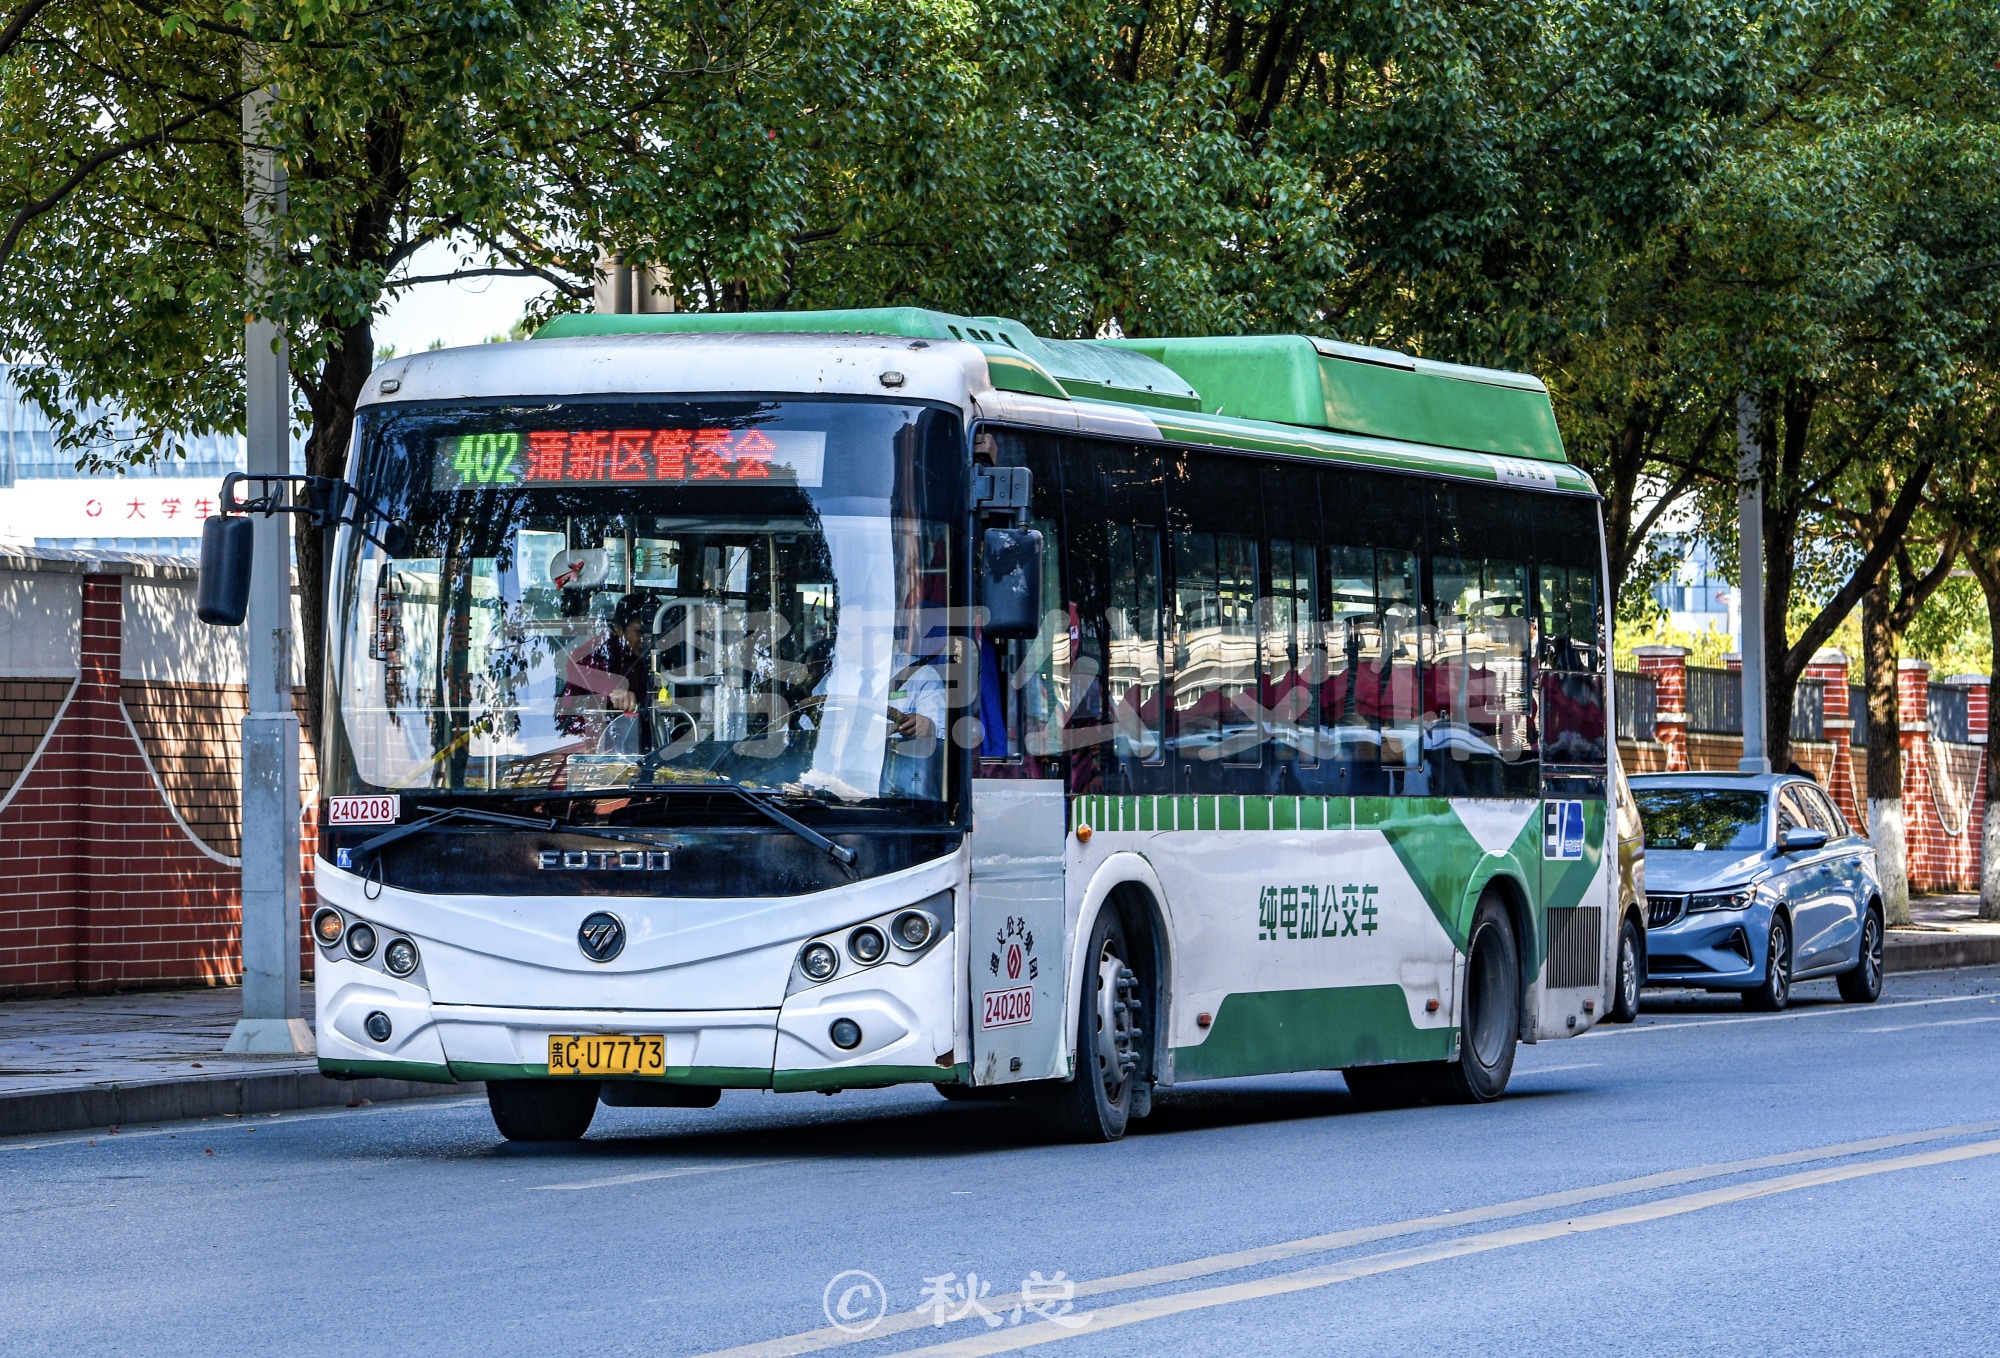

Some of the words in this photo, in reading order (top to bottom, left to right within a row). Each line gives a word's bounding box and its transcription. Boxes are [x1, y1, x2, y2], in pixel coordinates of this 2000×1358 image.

[453, 433, 518, 483] 402
[332, 800, 391, 821] 240208
[538, 851, 670, 870] FOTON
[1258, 883, 1379, 941] 纯电动公交车
[985, 991, 1031, 1024] 240208
